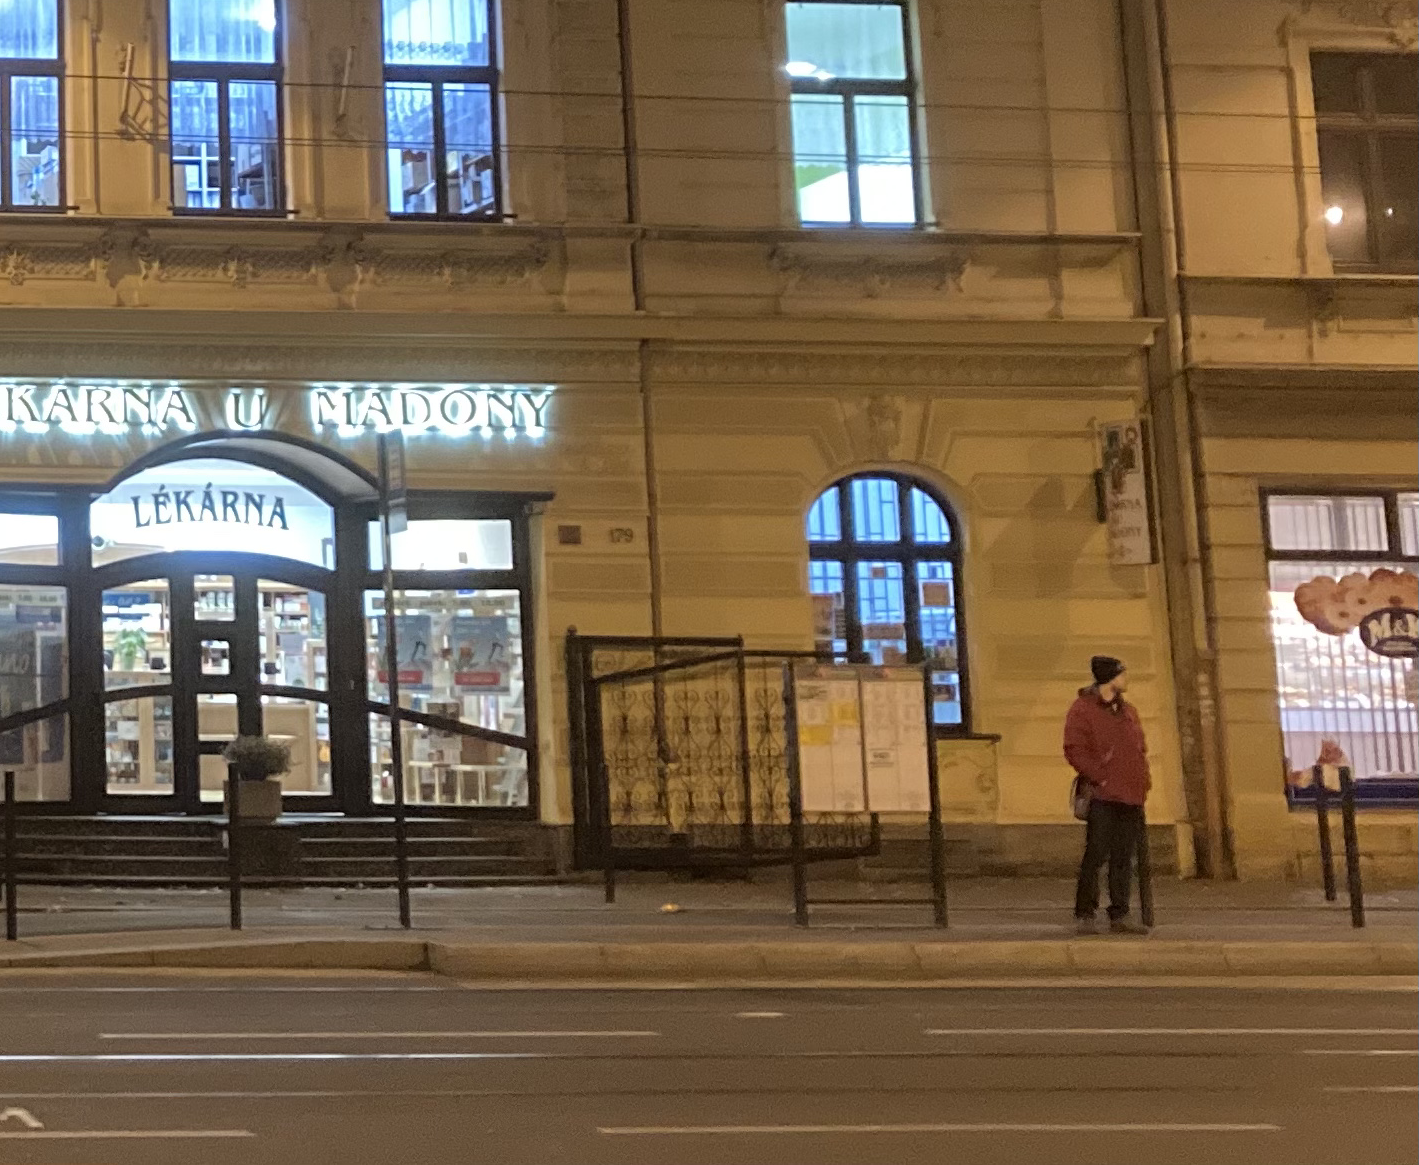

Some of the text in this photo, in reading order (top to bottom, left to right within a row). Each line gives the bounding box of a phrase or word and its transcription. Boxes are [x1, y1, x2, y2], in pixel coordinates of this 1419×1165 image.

[232, 391, 265, 429] U
[315, 389, 554, 429] MADONY
[130, 481, 290, 531] LÉKÁRNA
